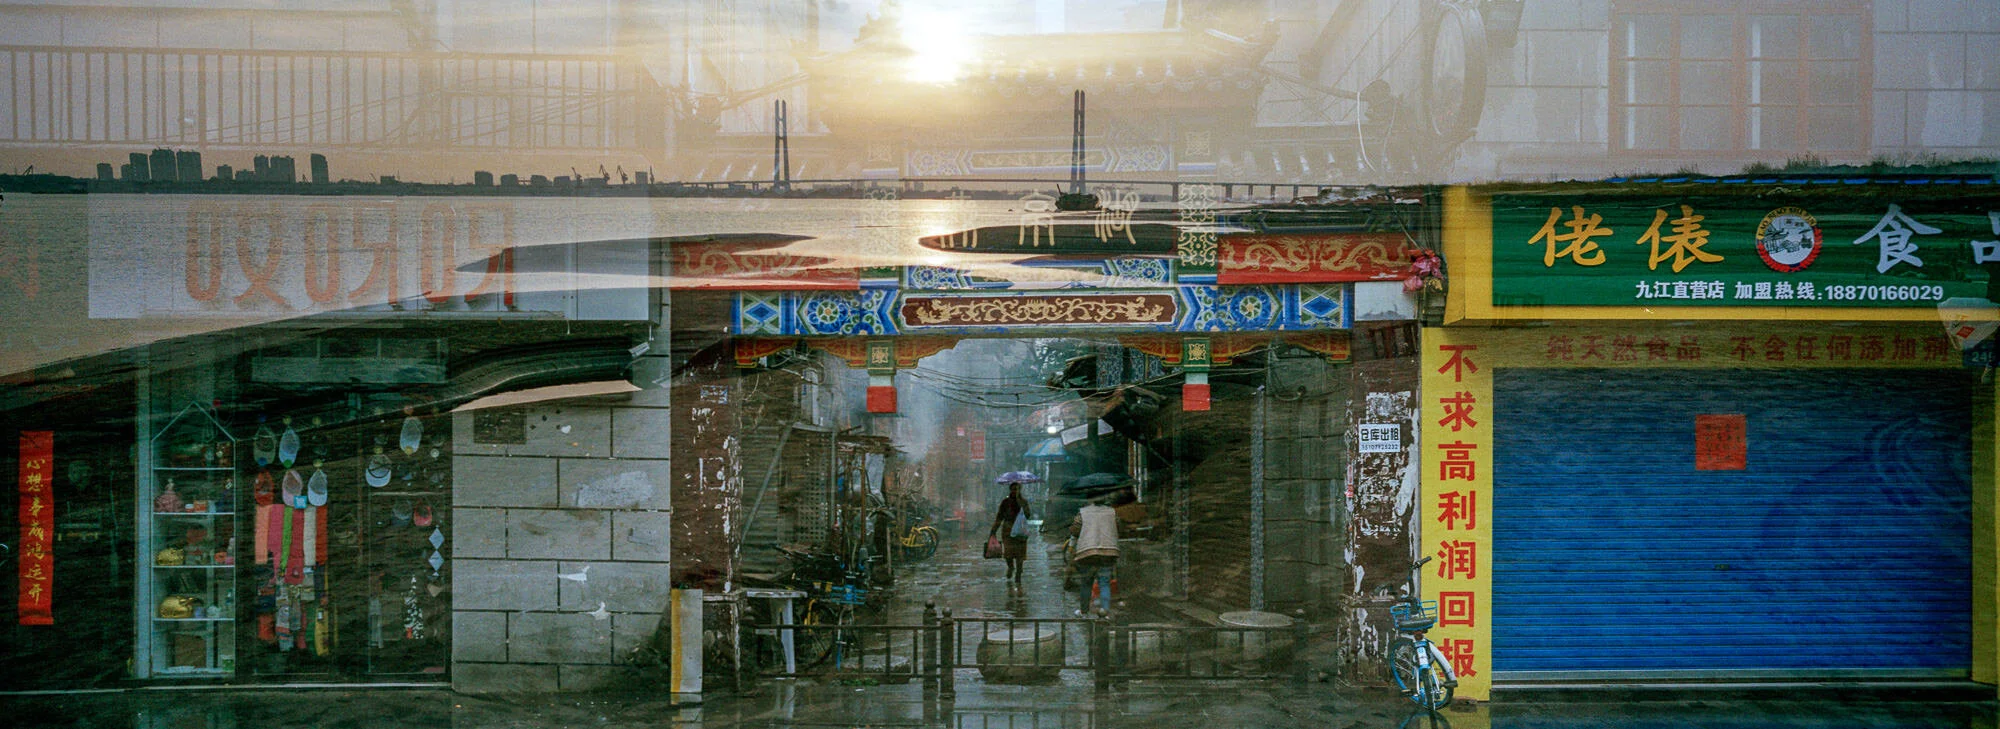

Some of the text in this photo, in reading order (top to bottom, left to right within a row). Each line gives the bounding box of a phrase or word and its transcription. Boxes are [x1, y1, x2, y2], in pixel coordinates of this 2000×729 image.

[1528, 205, 1723, 273] 佬俵
[1635, 281, 1725, 300] 九江直营店
[1546, 334, 1950, 363] 纯天然食品 不含任何添加剂
[1361, 428, 1399, 441] 仓库出租
[1437, 344, 1479, 678] 不求高利润回报
